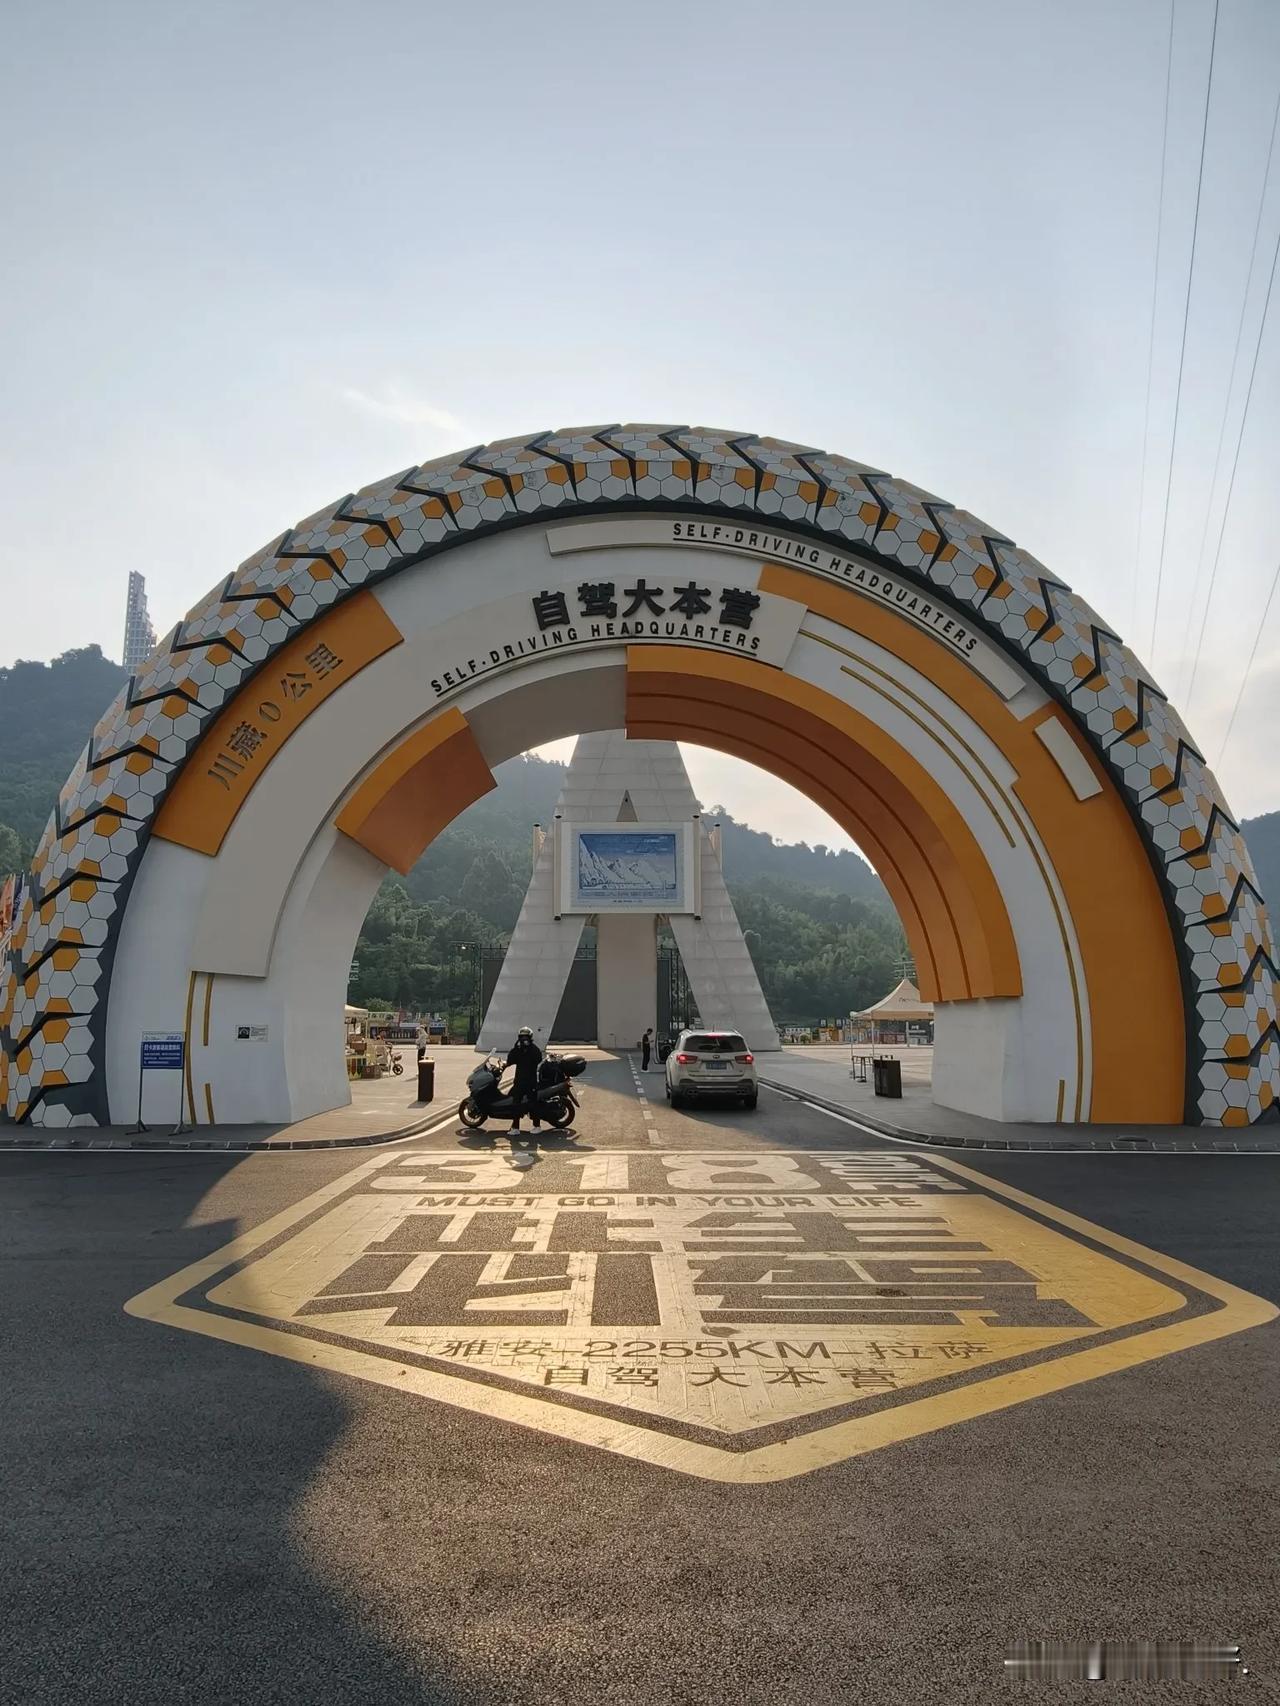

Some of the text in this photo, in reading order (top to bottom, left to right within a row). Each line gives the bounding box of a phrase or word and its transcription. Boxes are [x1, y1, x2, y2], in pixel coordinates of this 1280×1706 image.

[532, 579, 761, 631] 自驾大本营
[829, 557, 977, 651] HEADQUARTERS
[591, 621, 761, 651] HEADQUARTERS
[369, 1154, 822, 1190] 318
[809, 1154, 969, 1190] ROUTE
[415, 1196, 924, 1207] MUST GO IN YOUR LIFE
[362, 1211, 993, 1252] 此生
[291, 1253, 1102, 1328] 必驾
[544, 1365, 900, 1388] 自驾大本营
